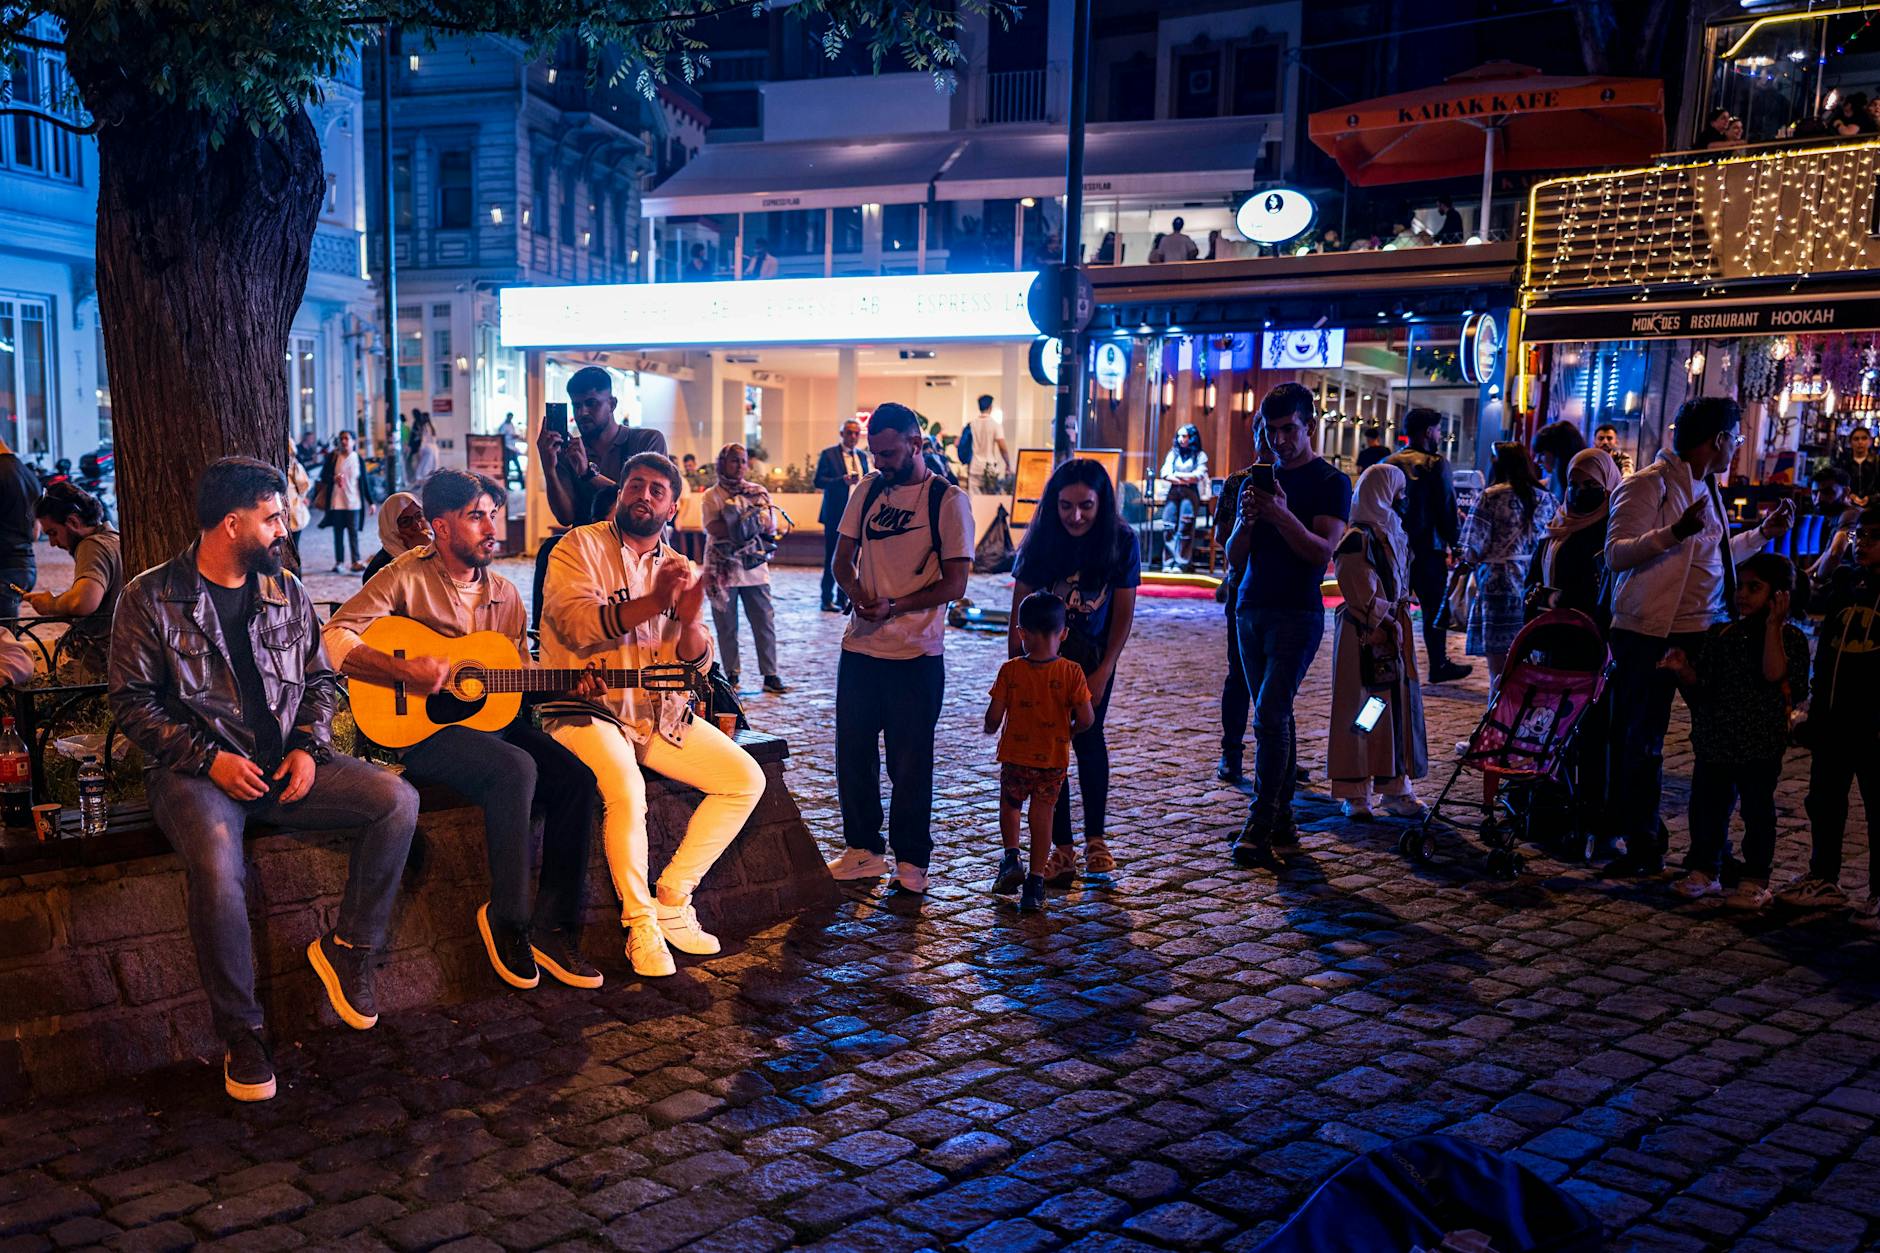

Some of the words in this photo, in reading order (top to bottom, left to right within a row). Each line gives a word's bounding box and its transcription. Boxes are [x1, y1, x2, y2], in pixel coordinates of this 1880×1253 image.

[1399, 97, 1484, 122] KARAK
[1491, 90, 1560, 111] KAFE
[1690, 312, 1760, 329] RESTAURANT
[1771, 308, 1834, 326] HOOKAH
